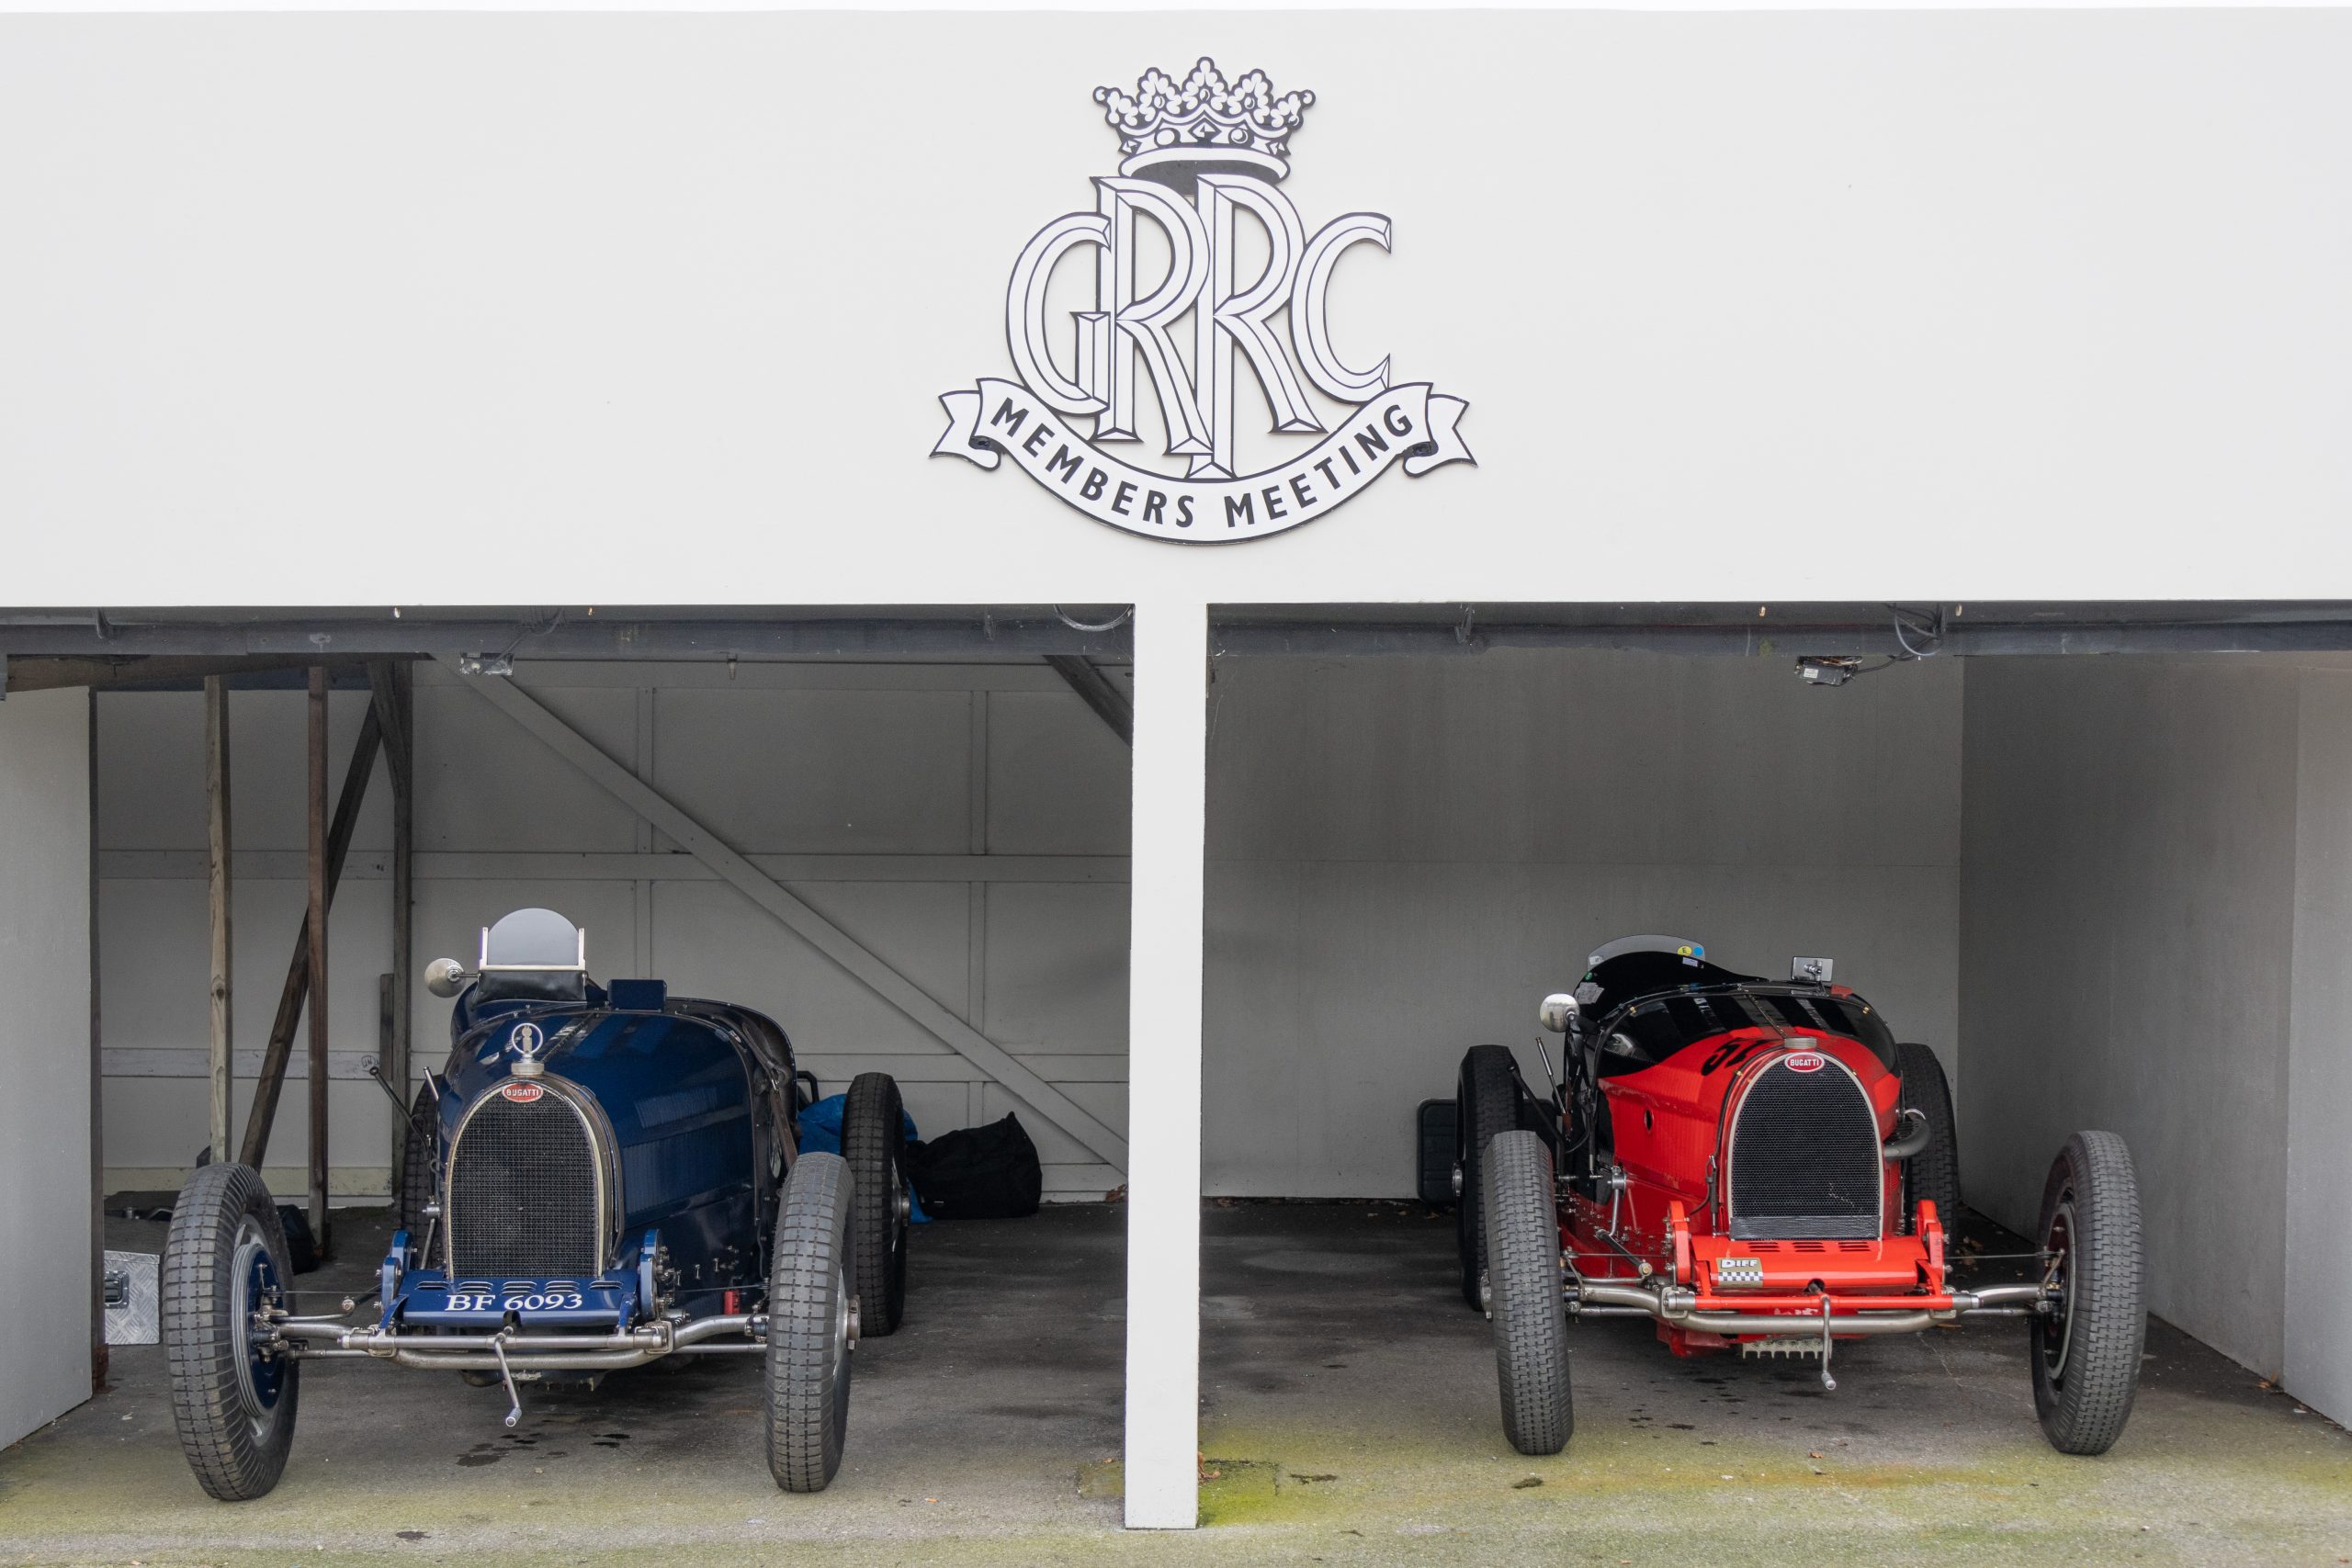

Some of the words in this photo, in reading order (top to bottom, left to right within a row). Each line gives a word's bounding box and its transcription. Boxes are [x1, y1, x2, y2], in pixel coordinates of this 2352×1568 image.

[1005, 173, 1392, 479] GRRC
[989, 396, 1195, 528] MEMBERS
[1225, 403, 1414, 528] MEETING
[1790, 1058, 1820, 1066] BUGATTI
[506, 1089, 539, 1097] BUGATTI
[445, 1294, 496, 1311] BF
[503, 1293, 582, 1310] 6093
